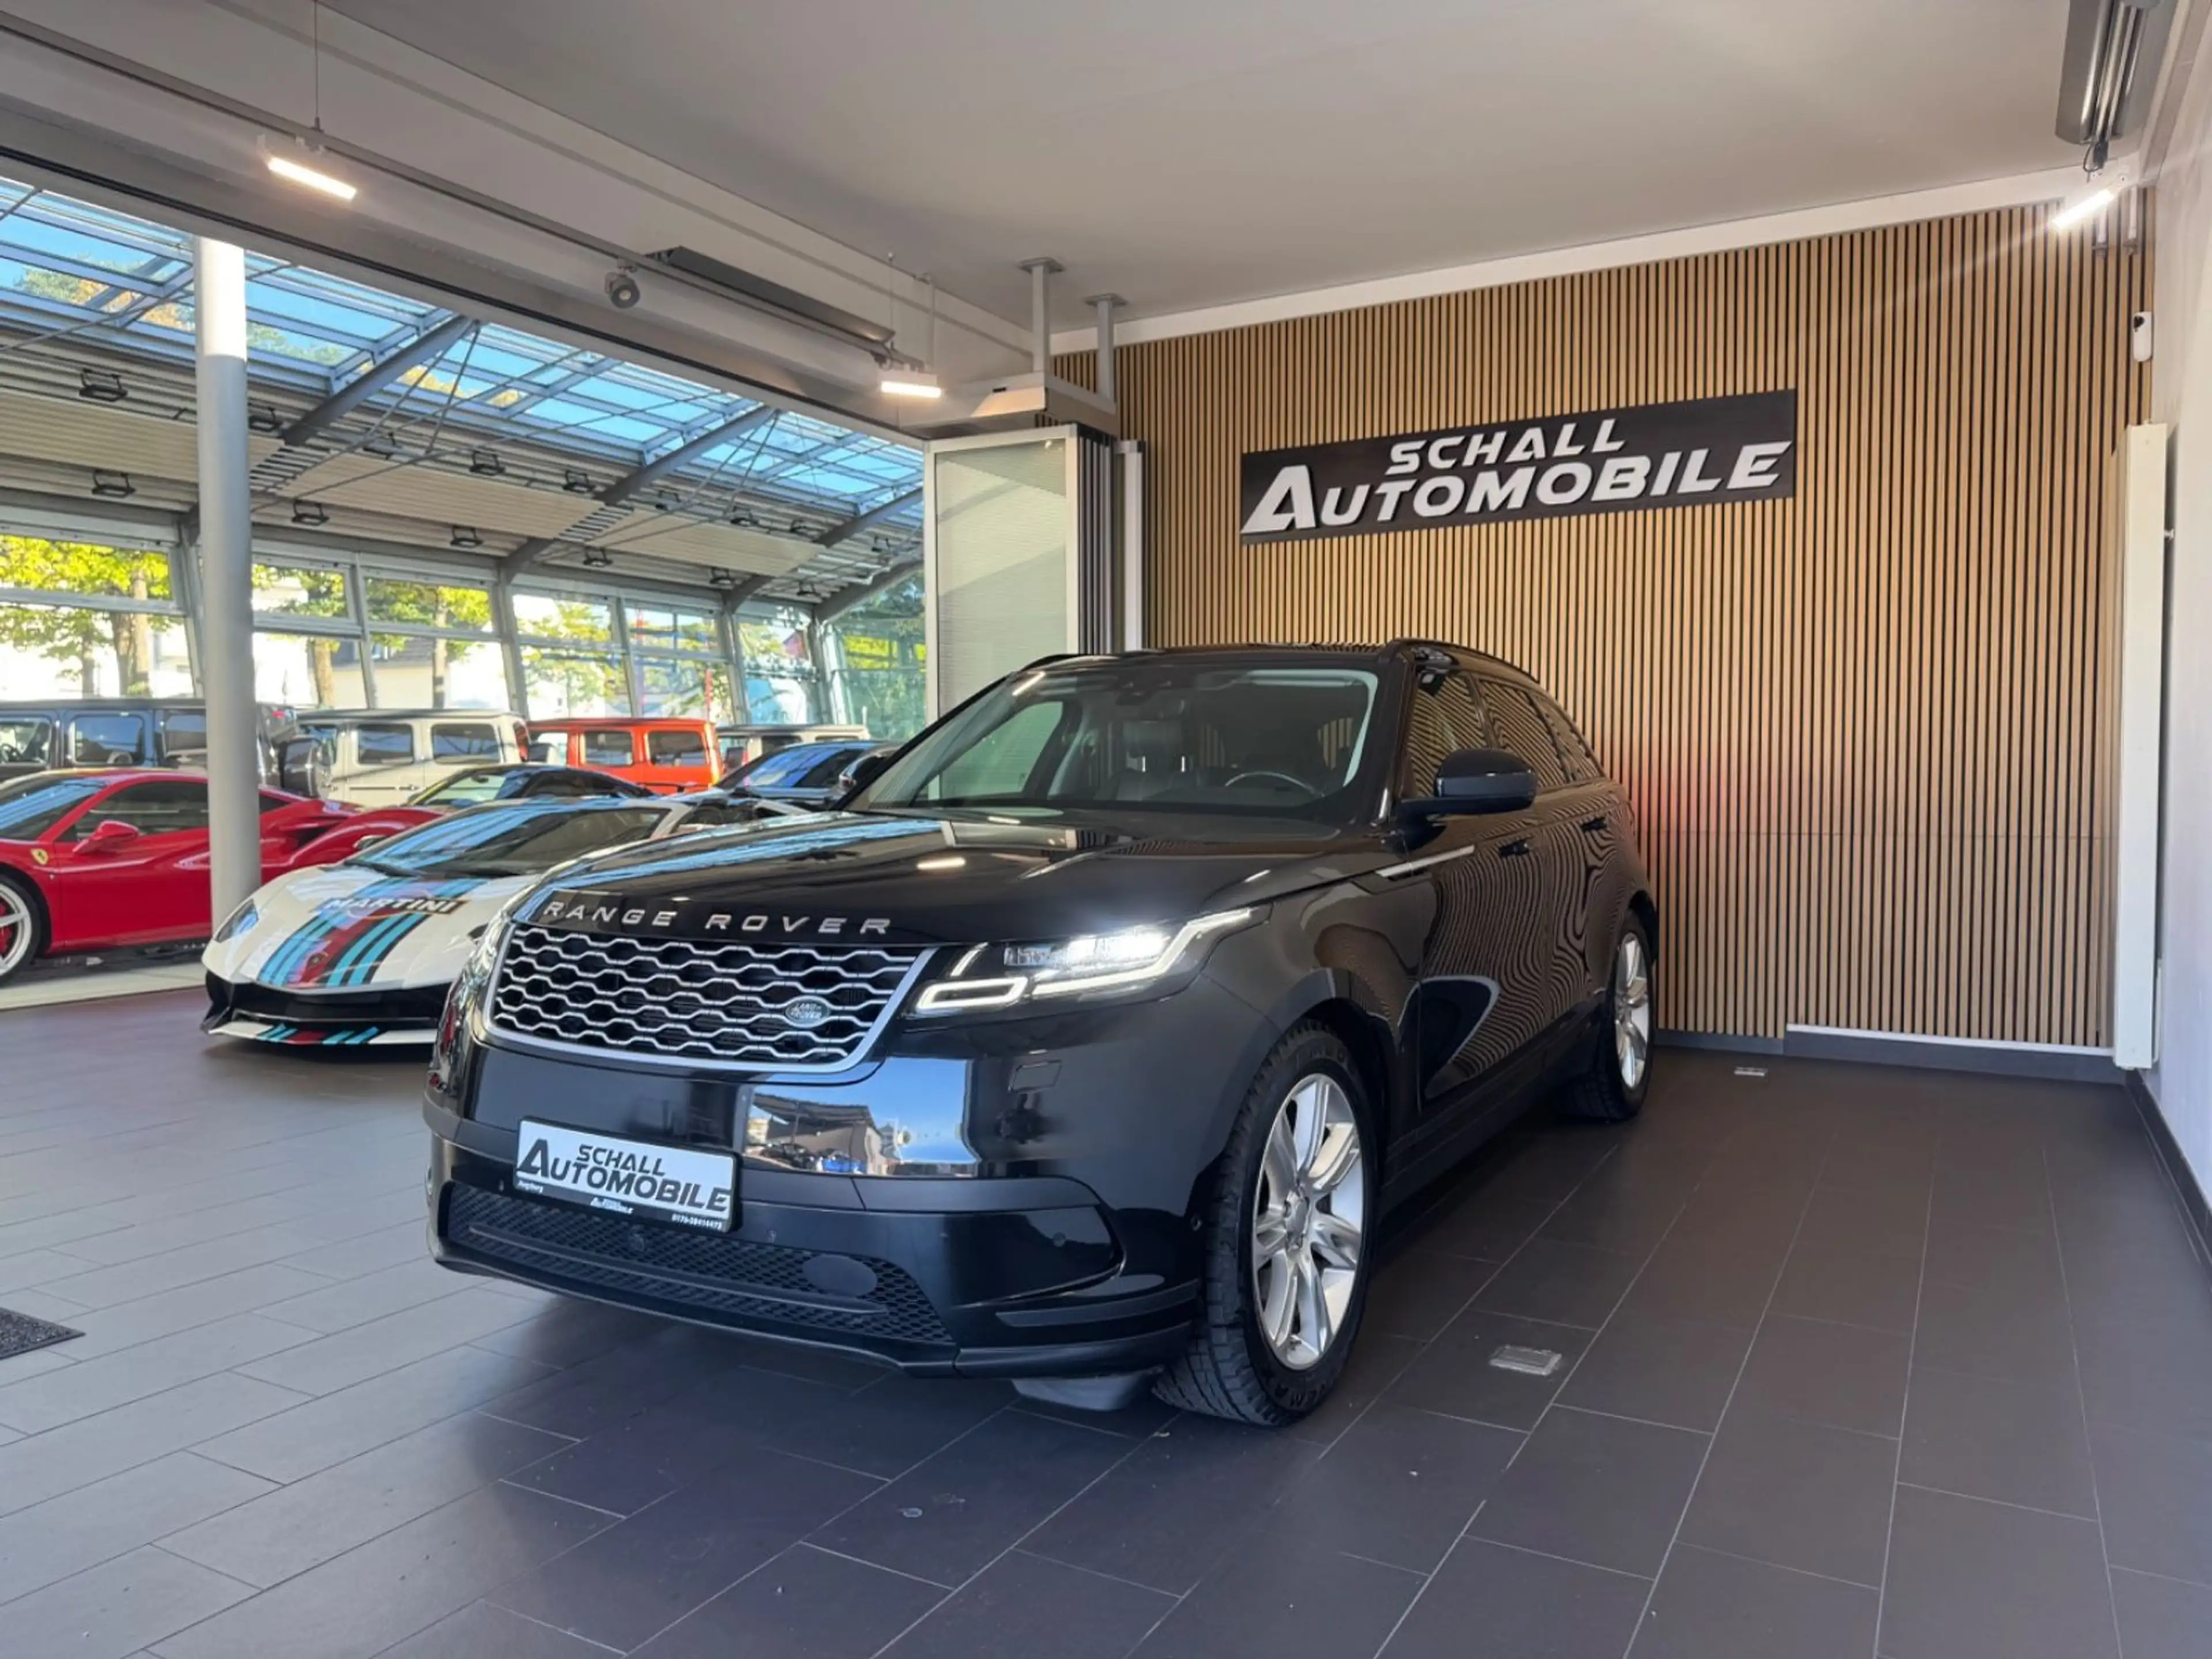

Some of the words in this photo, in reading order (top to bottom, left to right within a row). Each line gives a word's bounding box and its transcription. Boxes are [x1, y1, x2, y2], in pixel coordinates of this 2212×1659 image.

[1385, 418, 1624, 475] SCHALL
[1241, 440, 1791, 534] AUTOMOBILE
[323, 897, 460, 912] MARTINI
[543, 900, 677, 927] RANGE
[704, 913, 891, 935] ROVER
[517, 1138, 732, 1212] AUTOMOBILE
[576, 1143, 665, 1176] SCHALL
